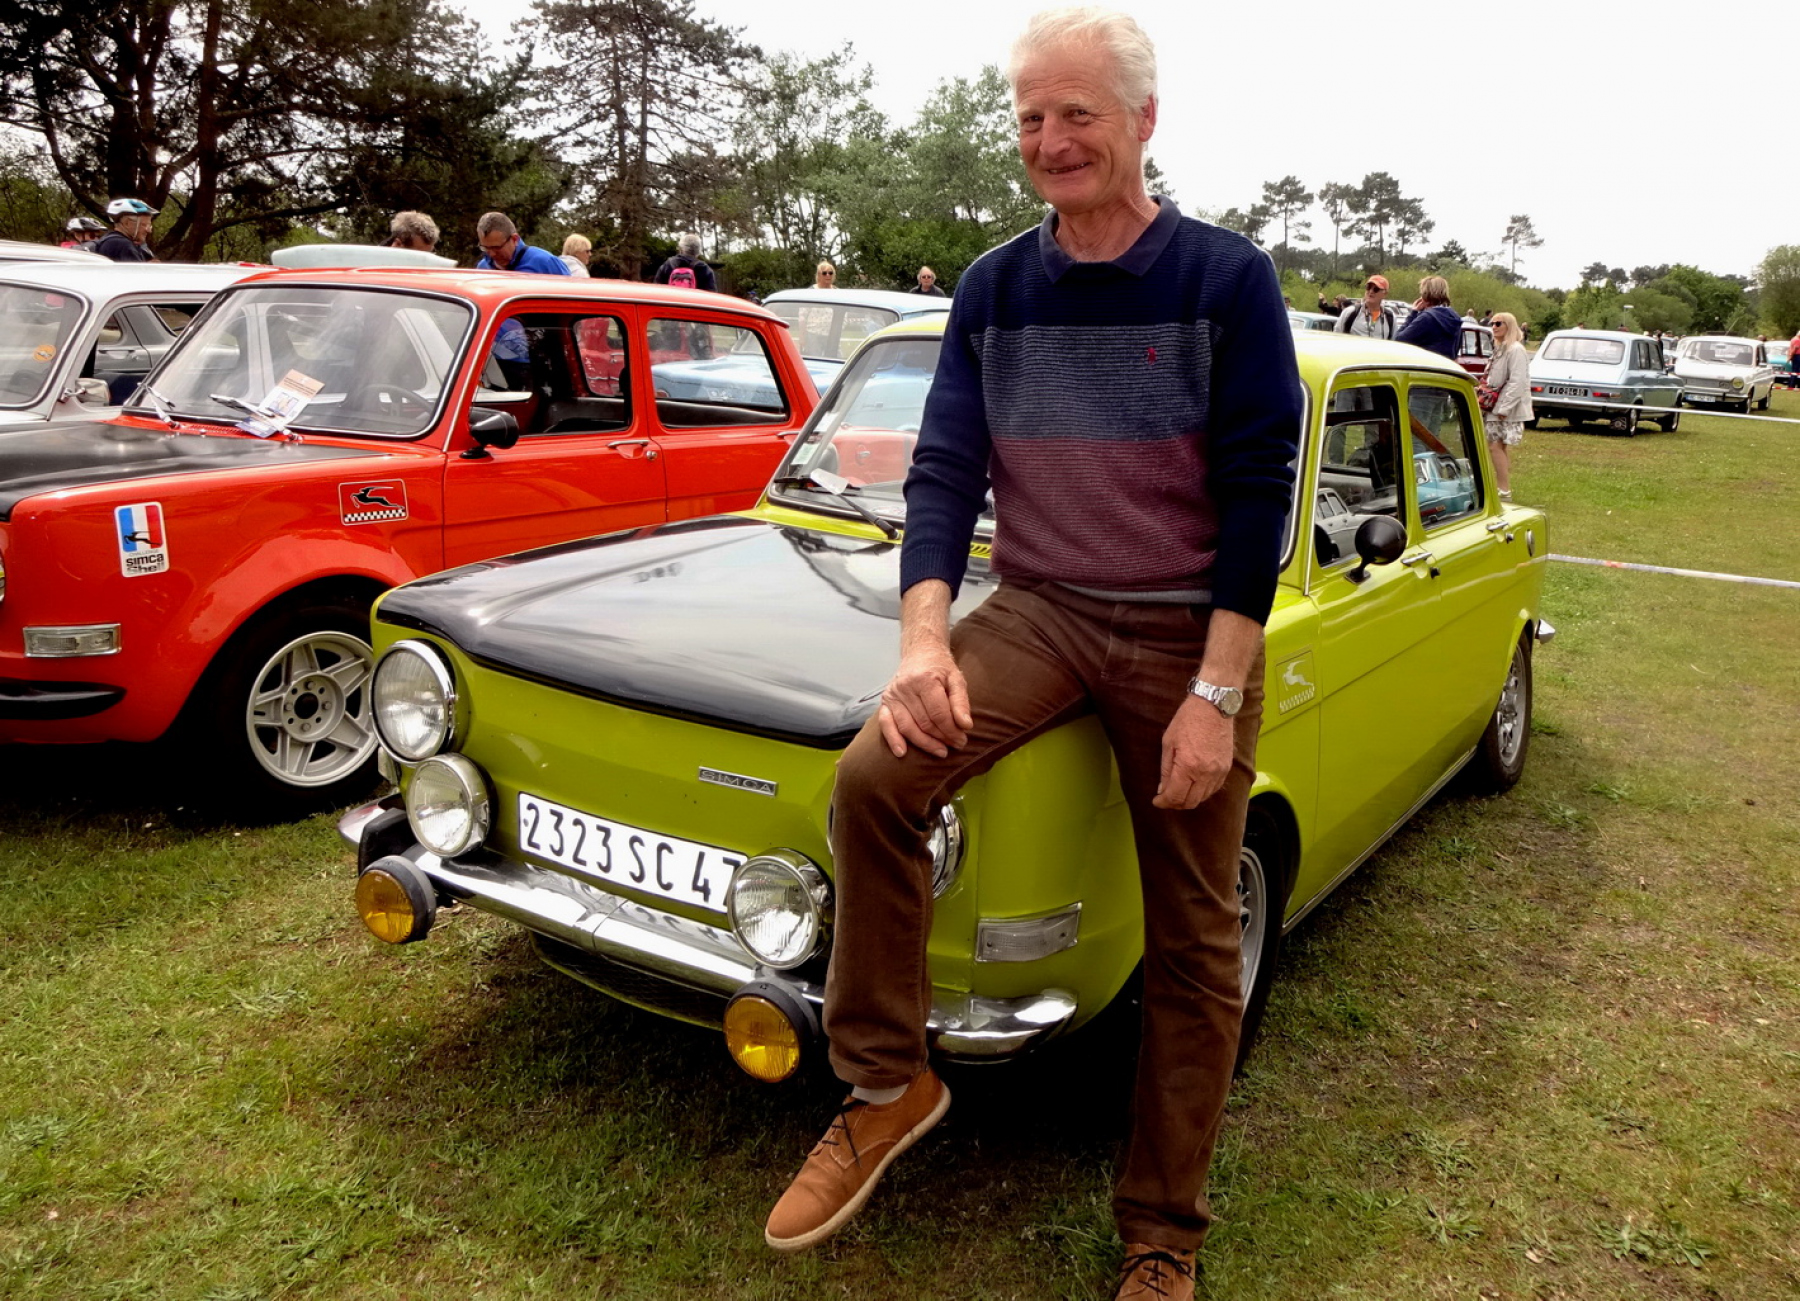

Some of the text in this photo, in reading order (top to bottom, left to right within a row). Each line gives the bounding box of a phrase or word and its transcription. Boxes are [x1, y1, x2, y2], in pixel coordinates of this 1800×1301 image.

[125, 553, 165, 567] simca
[701, 770, 772, 793] SIMCA
[526, 803, 612, 874] 2323
[629, 835, 674, 892] SC
